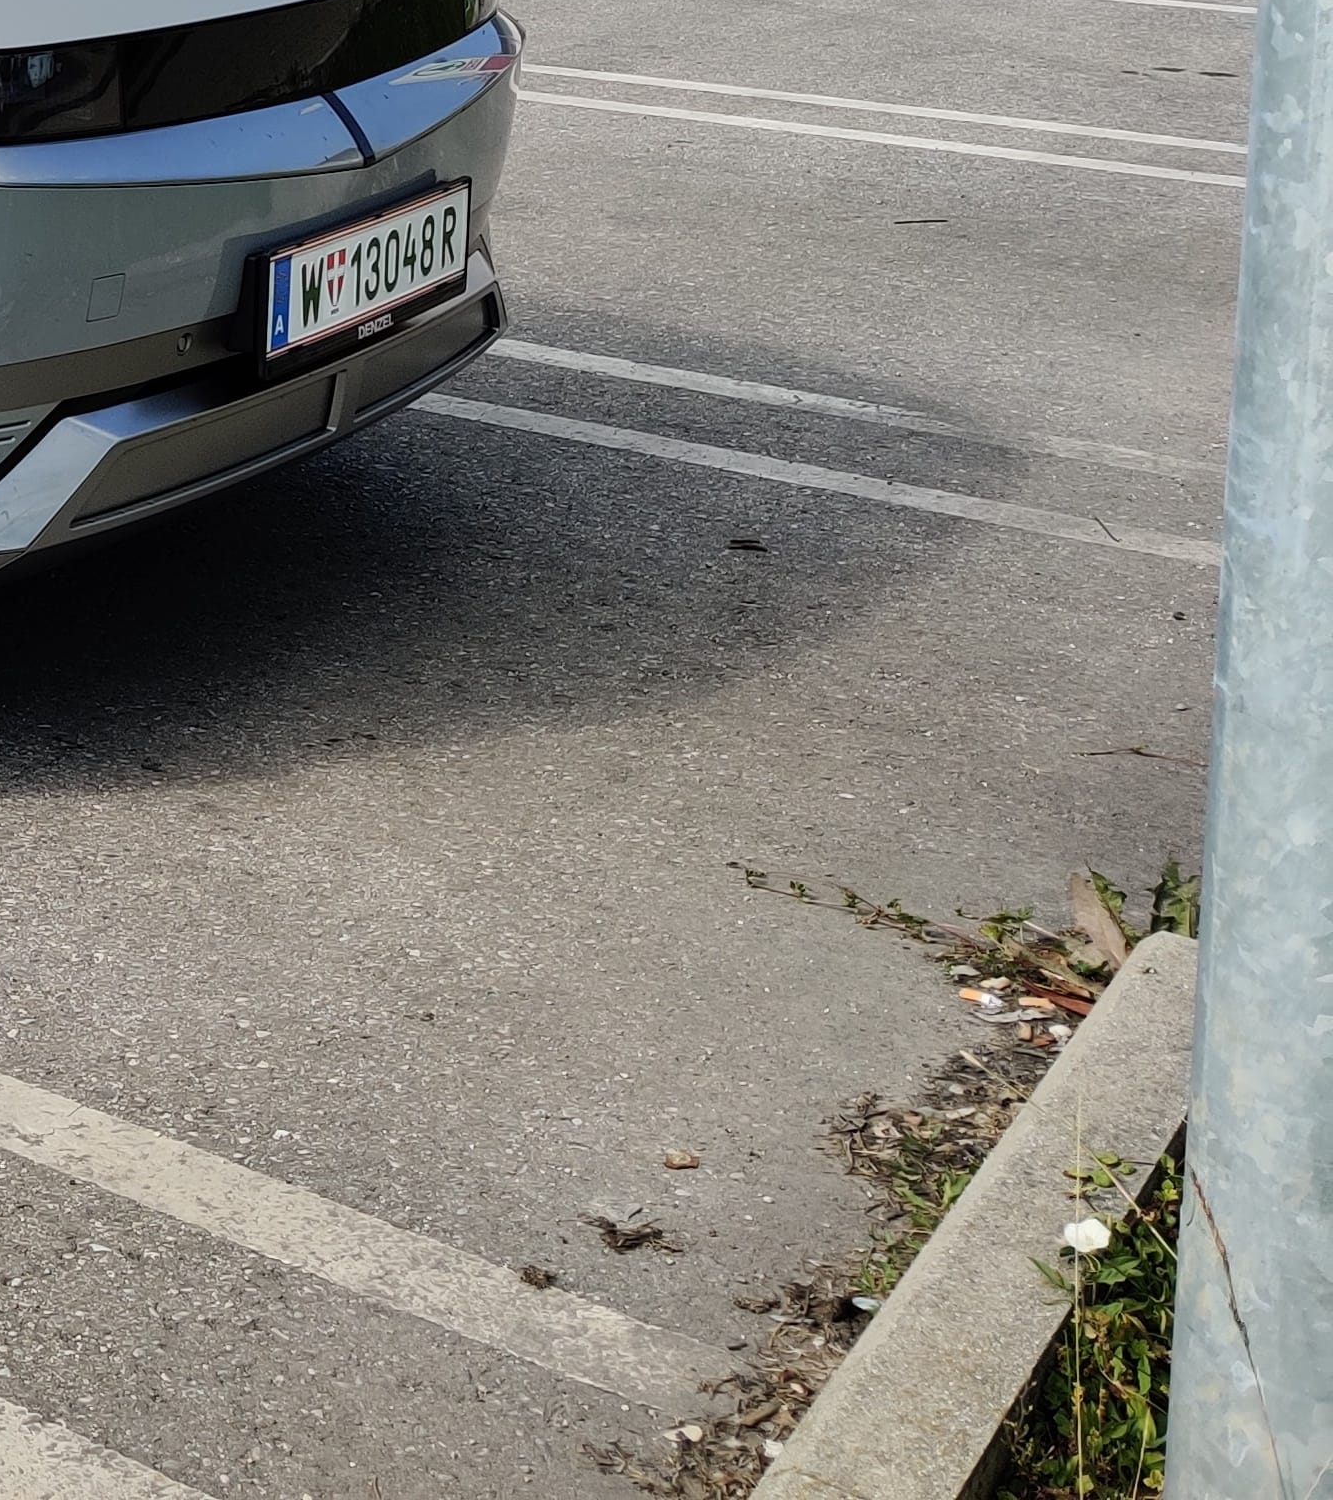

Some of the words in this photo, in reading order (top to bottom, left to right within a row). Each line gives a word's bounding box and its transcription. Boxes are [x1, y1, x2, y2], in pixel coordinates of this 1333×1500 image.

[301, 256, 325, 328] W
[274, 314, 285, 336] A
[357, 313, 394, 340] DENZEL
